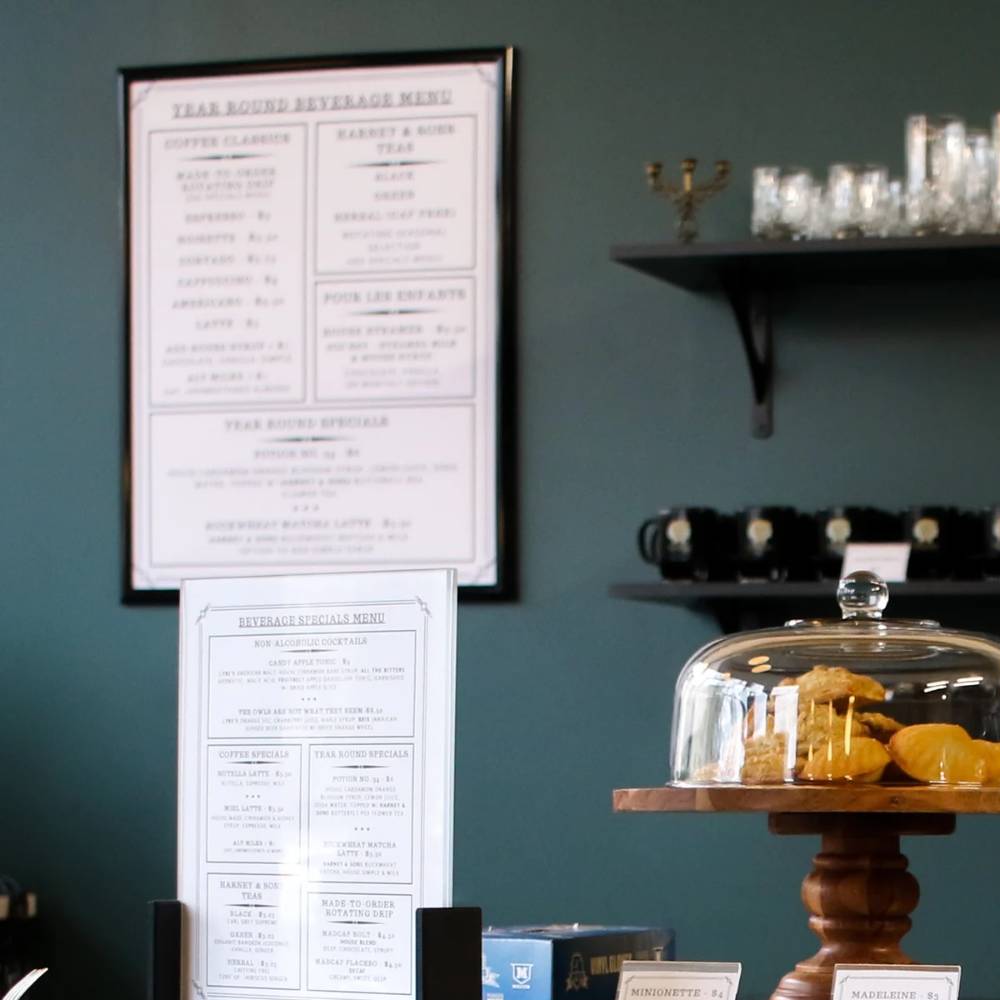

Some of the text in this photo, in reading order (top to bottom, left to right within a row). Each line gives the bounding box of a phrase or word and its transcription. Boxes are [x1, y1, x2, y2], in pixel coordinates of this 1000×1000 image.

[172, 89, 453, 118] YEAR ROUND BEVERAGE MENU
[238, 612, 386, 628] BEVERAGE SPECIALS MENU
[251, 750, 290, 758] SPECIALS
[314, 750, 409, 758] YEAR ROUND SPECIALS
[220, 880, 252, 890] HARNEY
[242, 892, 262, 900] TEAS
[326, 909, 394, 918] ROTATING DRIP
[631, 988, 702, 998] MINIONETTE
[852, 990, 917, 1000] MADELEINE
